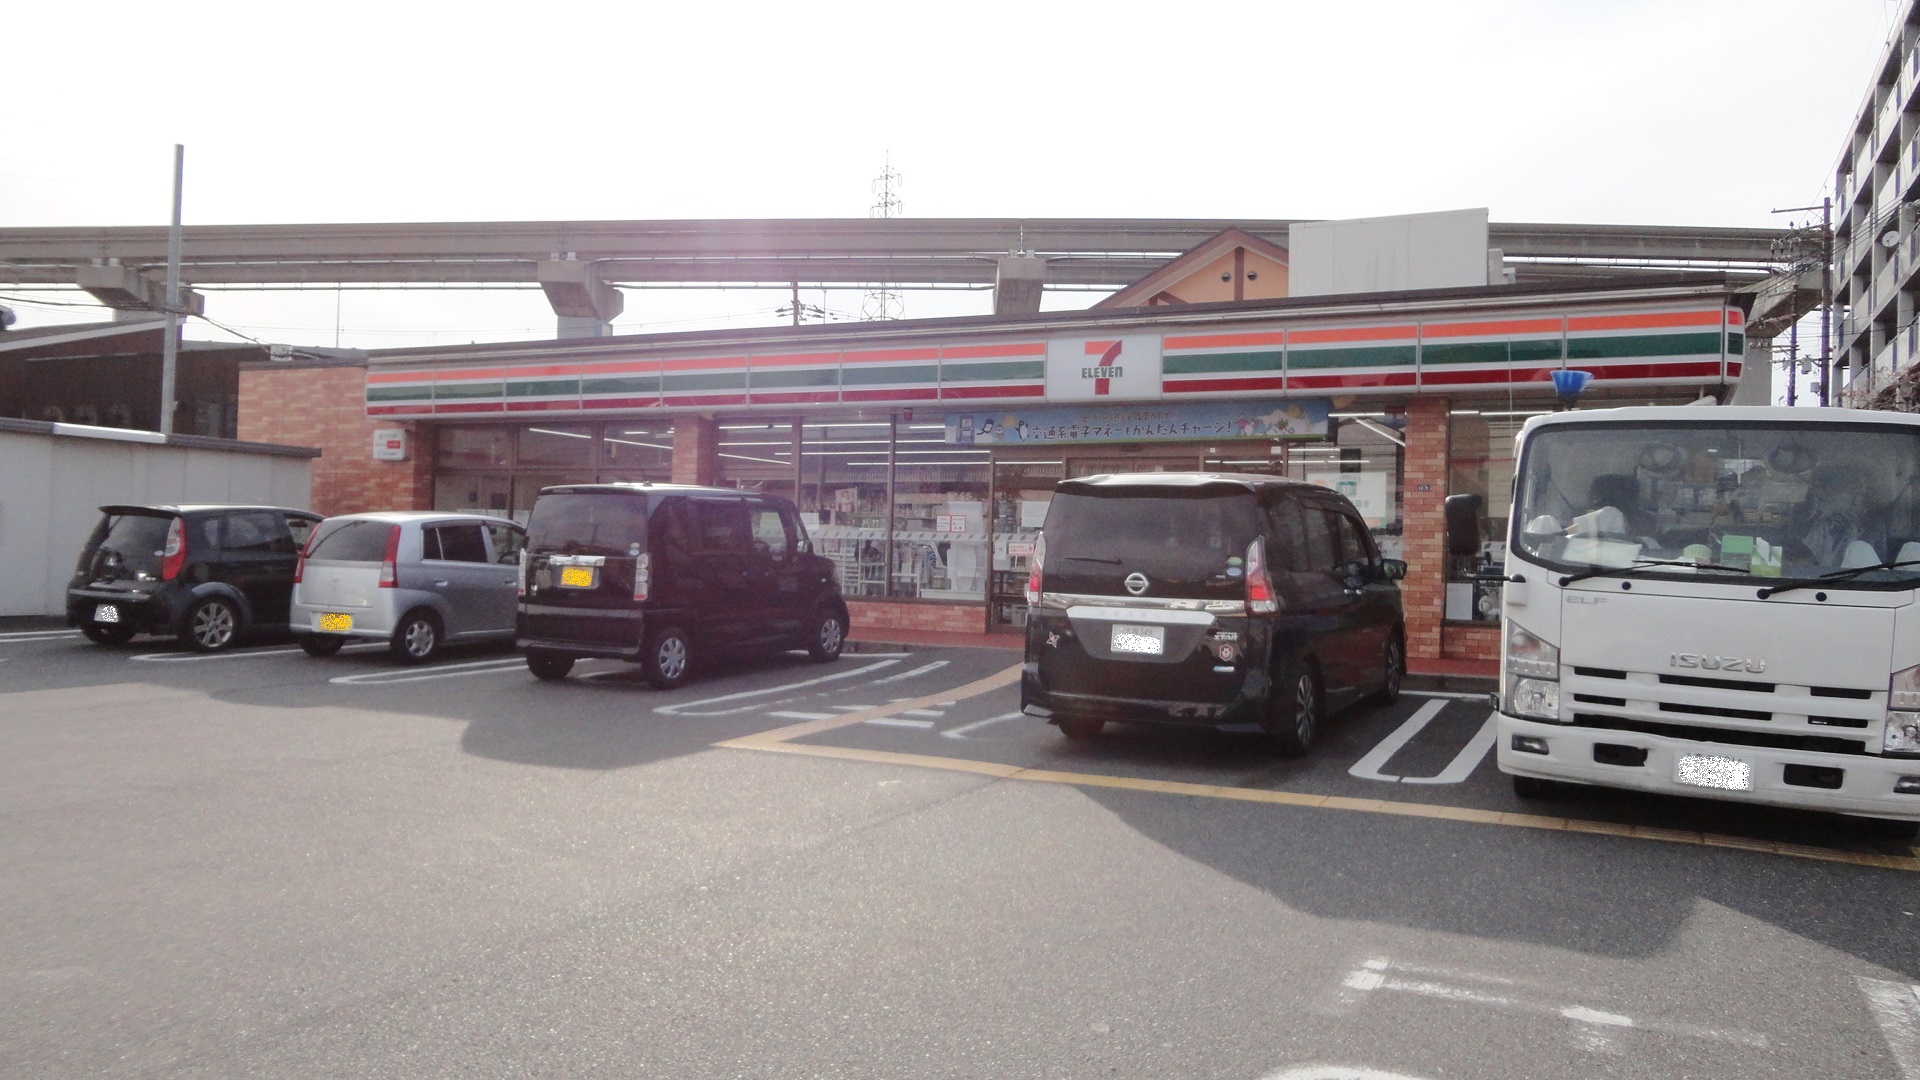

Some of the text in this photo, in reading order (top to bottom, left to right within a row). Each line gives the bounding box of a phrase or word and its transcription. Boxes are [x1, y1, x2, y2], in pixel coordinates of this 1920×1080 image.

[1084, 340, 1122, 395] 7
[1566, 595, 1608, 605] ELF
[1670, 652, 1766, 674] ISUZU
